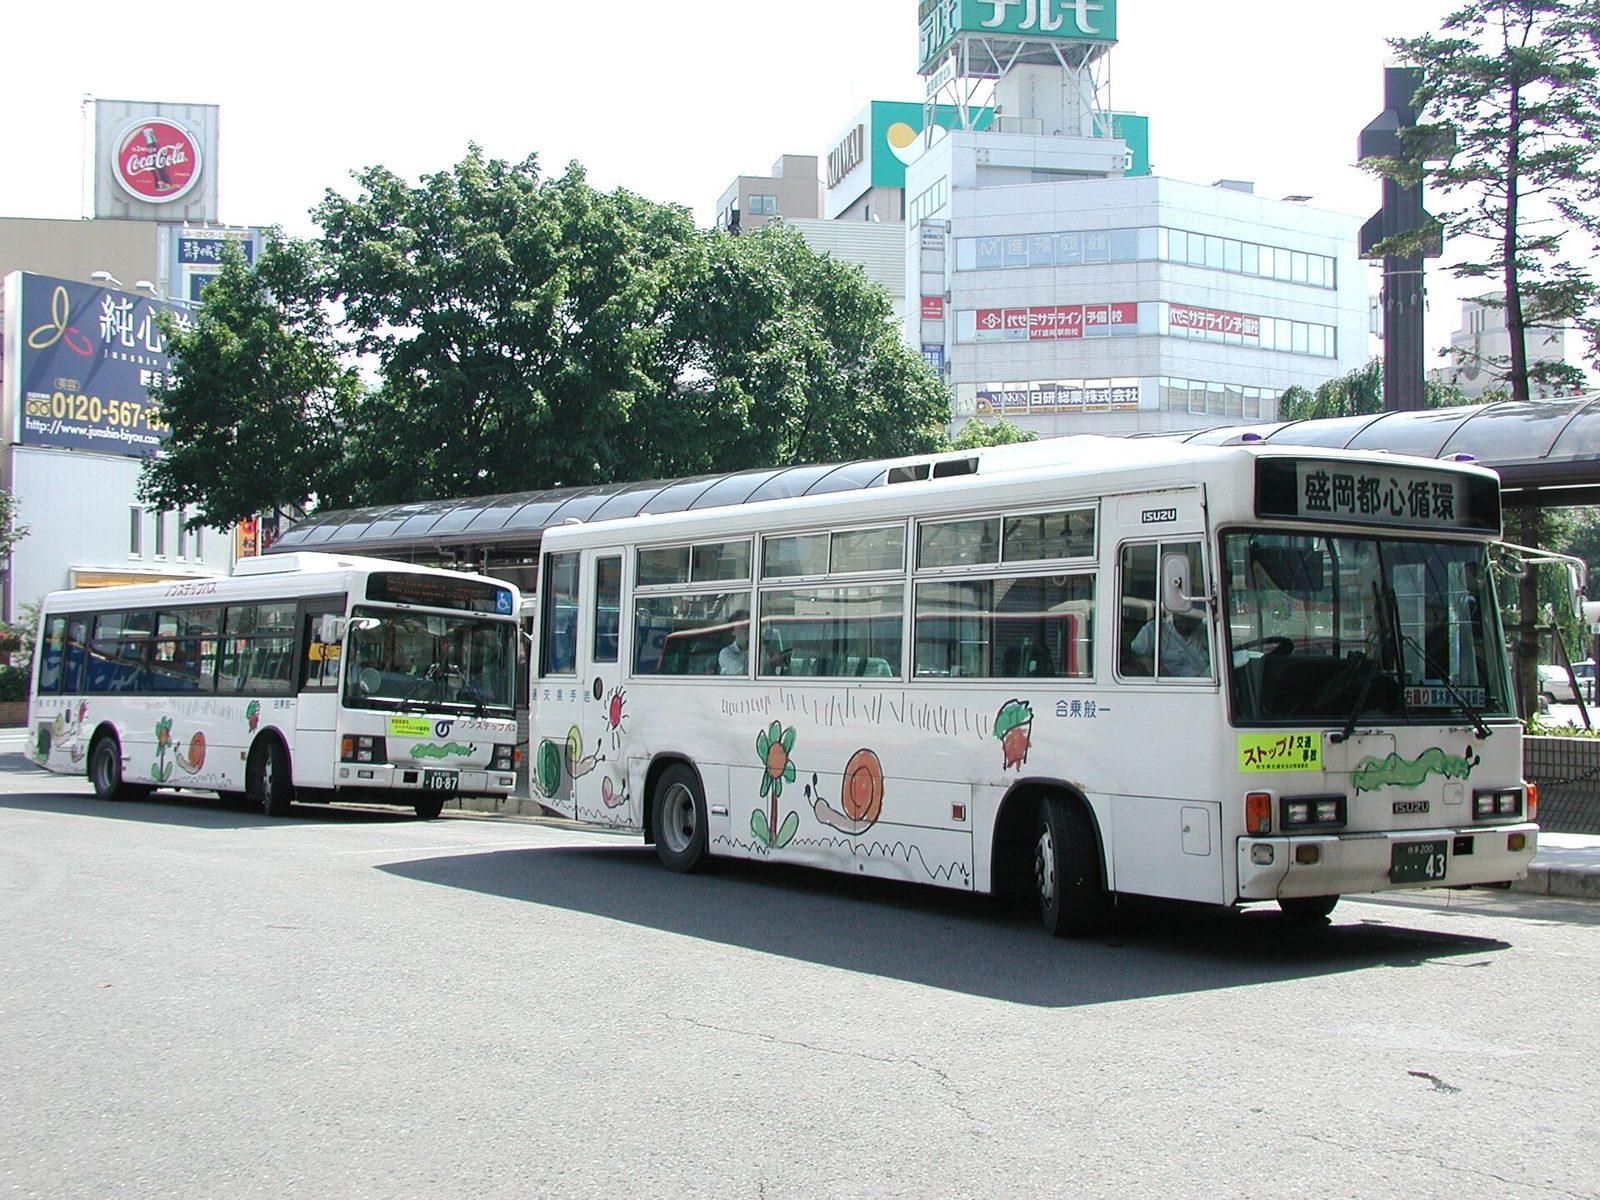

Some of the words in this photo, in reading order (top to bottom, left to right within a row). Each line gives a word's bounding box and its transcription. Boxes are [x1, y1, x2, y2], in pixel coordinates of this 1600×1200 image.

[1305, 471, 1455, 521] 盛岡都心循環
[1143, 510, 1176, 522] ISUZU
[1395, 802, 1430, 813] ISUZU
